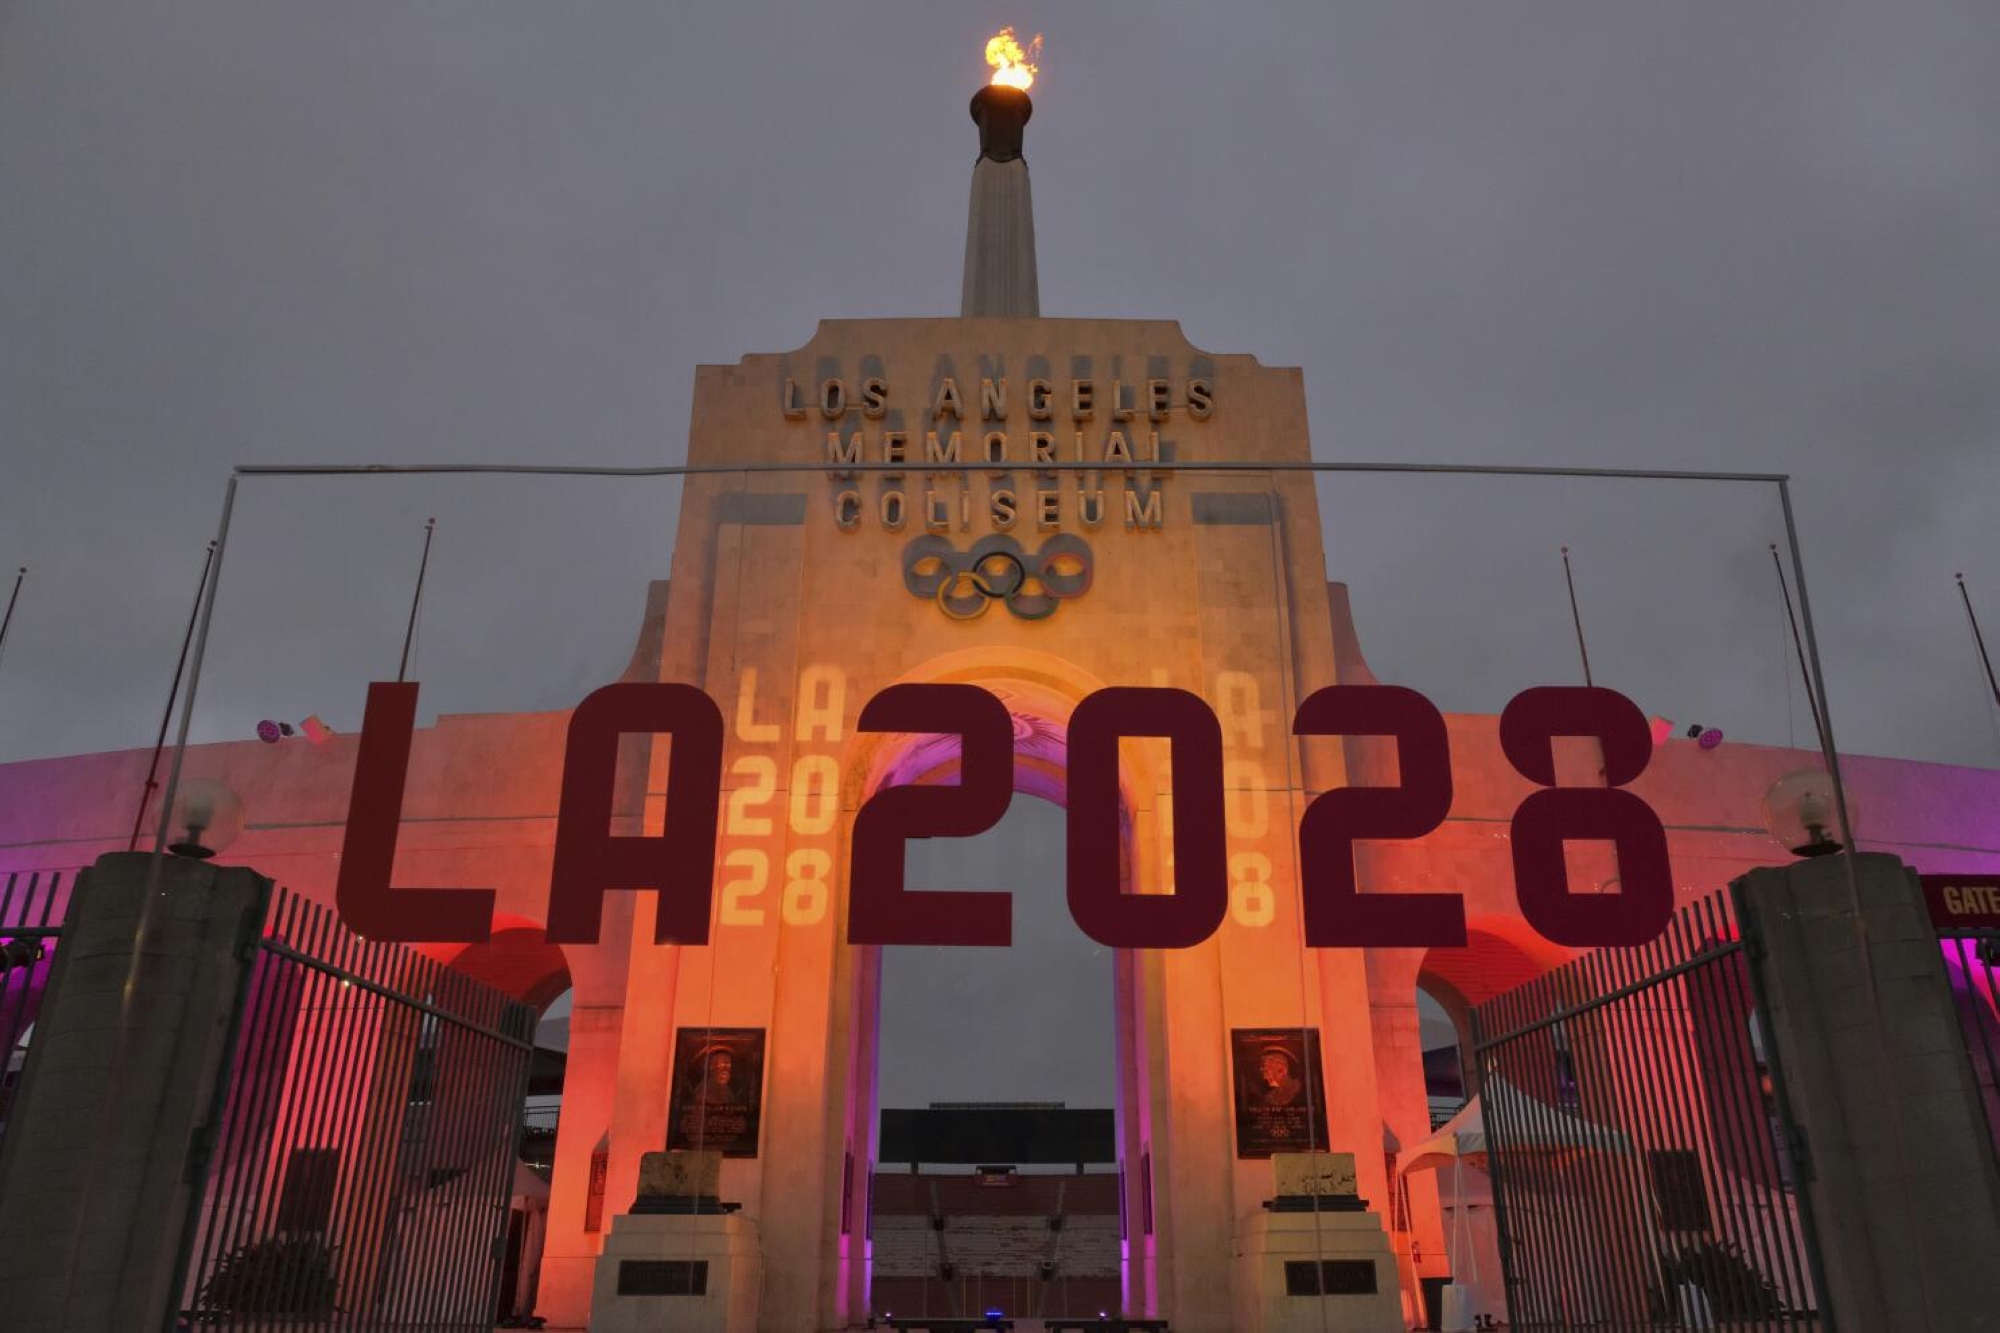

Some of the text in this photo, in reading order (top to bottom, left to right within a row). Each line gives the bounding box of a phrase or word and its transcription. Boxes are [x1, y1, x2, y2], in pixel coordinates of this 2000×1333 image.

[784, 377, 1213, 422] LOS ANGELES
[827, 431, 1173, 479] MEMORIAL
[836, 490, 1163, 533] COLISEUM
[736, 665, 846, 742] LA
[336, 682, 1674, 948] LA 2028
[727, 755, 840, 835] 20
[720, 848, 832, 926] 28
[1942, 887, 2000, 915] GATE
